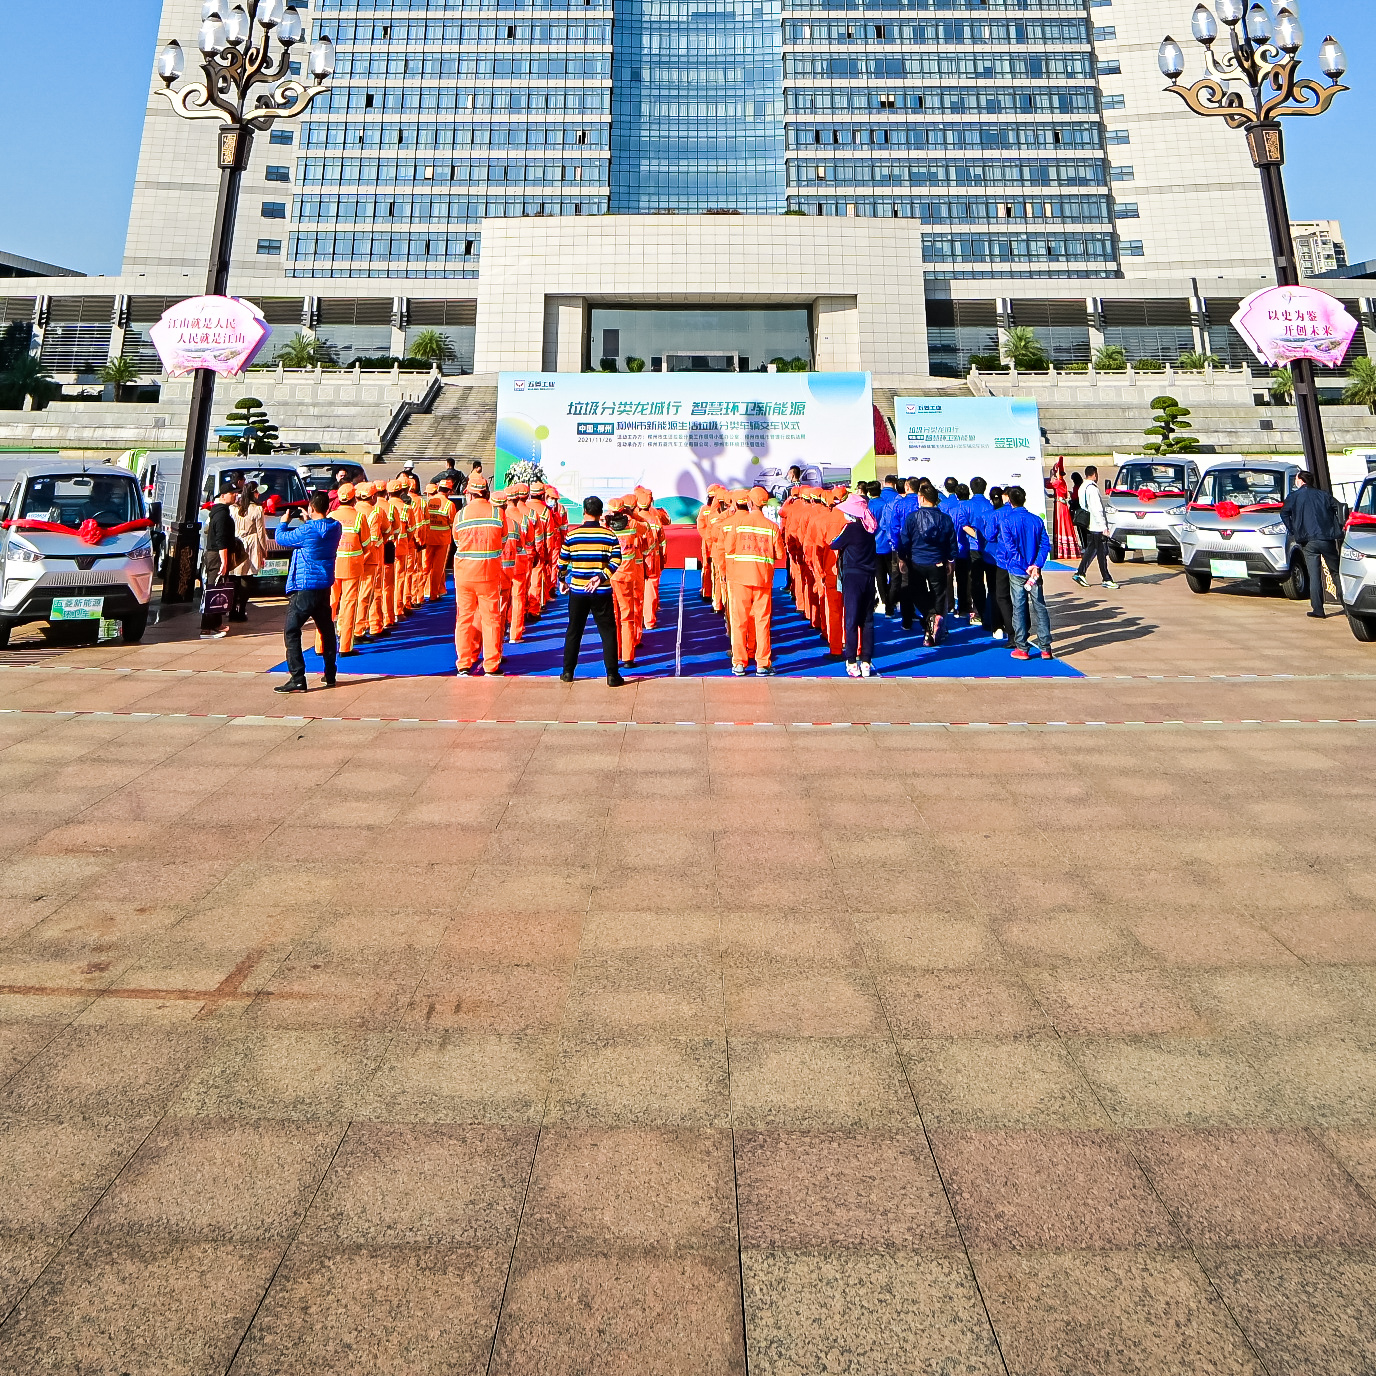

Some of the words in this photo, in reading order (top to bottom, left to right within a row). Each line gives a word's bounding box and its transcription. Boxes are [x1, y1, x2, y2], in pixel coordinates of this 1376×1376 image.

[1267, 309, 1318, 322] 以史为鉴
[167, 317, 237, 329] 江山就是人民
[1284, 324, 1333, 337] 开创未来
[176, 332, 246, 344] 人民就是江山
[567, 401, 682, 416] 垃圾分类龙城行
[691, 401, 807, 416] 智慧环卫新能源
[578, 424, 613, 434] 中国·柳州
[616, 421, 801, 431] 柳州市新能源生活垃圾分类车辆交车仪式
[994, 437, 1030, 449] 签到处
[53, 598, 102, 608] 五菱新能源
